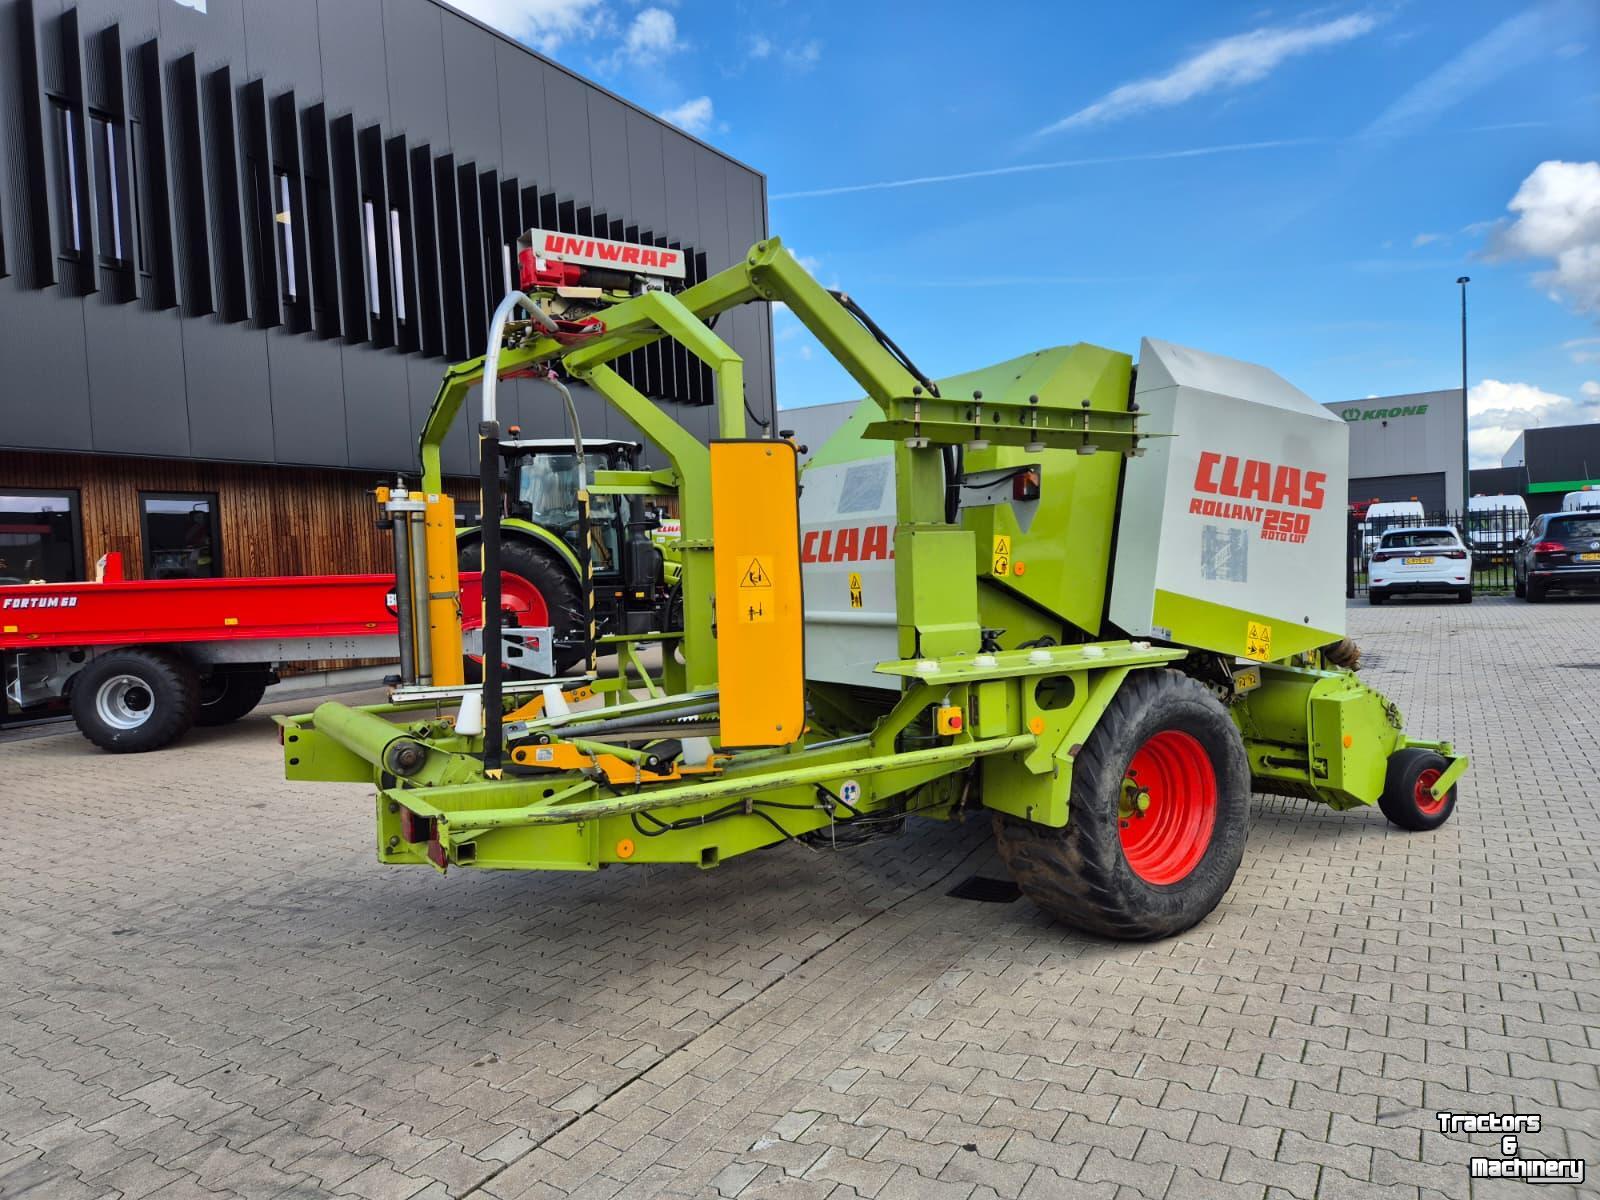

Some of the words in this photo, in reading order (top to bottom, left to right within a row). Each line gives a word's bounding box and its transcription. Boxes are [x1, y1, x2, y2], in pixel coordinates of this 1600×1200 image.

[544, 234, 678, 268] UNIWRAP
[1361, 405, 1429, 420] KRONE
[1194, 451, 1327, 510] CLAAS
[1189, 498, 1264, 522] ROLLANT
[1262, 509, 1311, 535] 250
[1260, 529, 1287, 541] ROTO
[1289, 533, 1306, 544] CUT
[3, 597, 59, 609] FORTUM
